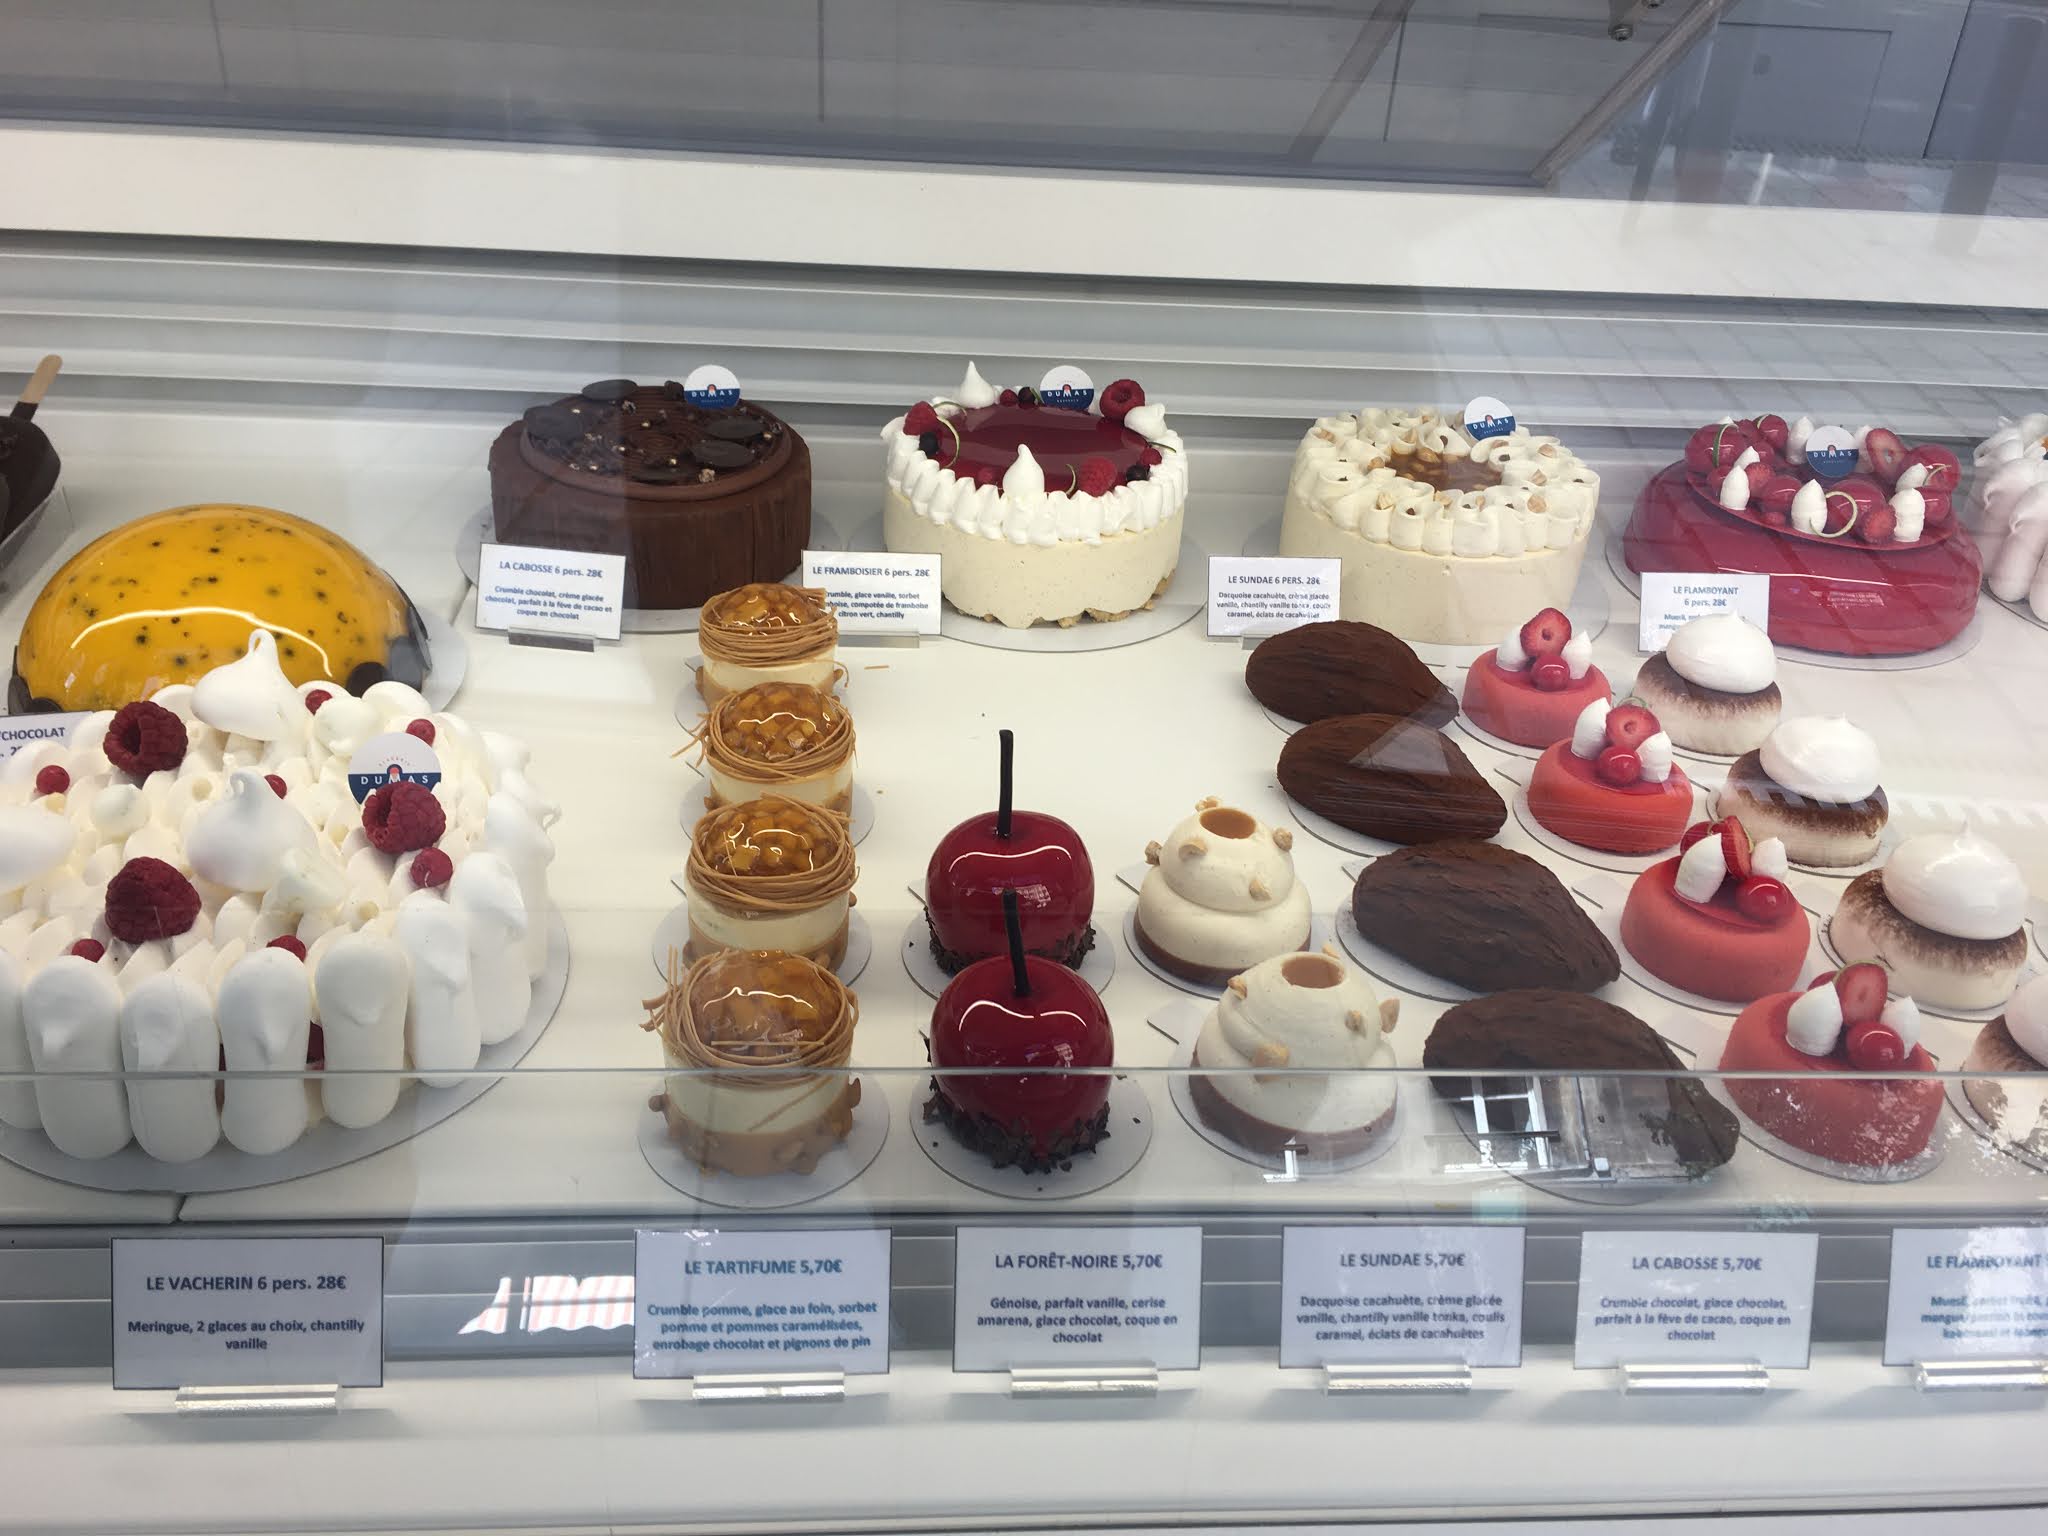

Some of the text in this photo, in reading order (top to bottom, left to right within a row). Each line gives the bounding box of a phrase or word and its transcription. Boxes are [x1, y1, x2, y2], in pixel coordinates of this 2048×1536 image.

[1473, 418, 1508, 429] DUMAS
[499, 561, 603, 578] LA CABOSSE 6 pers. 28€
[825, 567, 882, 576] FRAMBOISIER
[885, 568, 890, 576] 6
[892, 570, 912, 578] pers.
[915, 569, 930, 577] 28€
[1240, 576, 1273, 584] SUNDAE
[1306, 577, 1320, 585] 28€
[495, 586, 603, 602] Crumble chocolat, crème glacée
[826, 591, 852, 599] rumble,
[1219, 592, 1251, 600] Dacquoise
[485, 595, 516, 605] chocolat,
[518, 598, 541, 607] parfait
[851, 601, 884, 609] compotée
[517, 608, 537, 617] coque
[550, 610, 579, 620] chocolat
[876, 611, 904, 619] chantilly
[0, 727, 65, 740] CHOCOLAT
[361, 775, 428, 784] DUMAS
[996, 1252, 1163, 1270] LA FORÊT-NOIRE 5,70€
[1340, 1254, 1465, 1268] LE SUNDAE 5,70€
[1633, 1257, 1762, 1272] LA CABOSSE 5,70€
[1927, 1256, 1942, 1268] LE
[685, 1260, 842, 1275] LE TARTIFUME 5,70€
[147, 1275, 346, 1293] LE VACHERIN 6 pers. 28€
[991, 1297, 1165, 1310] Génoise, parfait vanille, cerise
[1301, 1295, 1502, 1308] Dacquoise cacahuète, crème glacée
[1601, 1298, 1787, 1310] Crumble chocolat, glace chocolat,
[648, 1302, 877, 1318] Crumble pomme, glace au foin, sorbet
[977, 1315, 1177, 1328] amarena, glace chocolat, coque en
[1297, 1312, 1505, 1324] vanille, chantilly vanille tonka, coulis
[1595, 1314, 1790, 1326] parfait à la fève de cacao, coque en
[128, 1319, 364, 1335] Meringue, 2 glaces au choix, chantilly
[661, 1319, 863, 1335] pomme et pommes caramélisées,
[1053, 1332, 1103, 1343] chocolat
[1316, 1329, 1484, 1341] caramel, éclats de cacahuètes
[1668, 1330, 1715, 1340] chocolat
[225, 1338, 267, 1350] vanille
[653, 1337, 871, 1351] enrobage chocolat et pignons de pin
